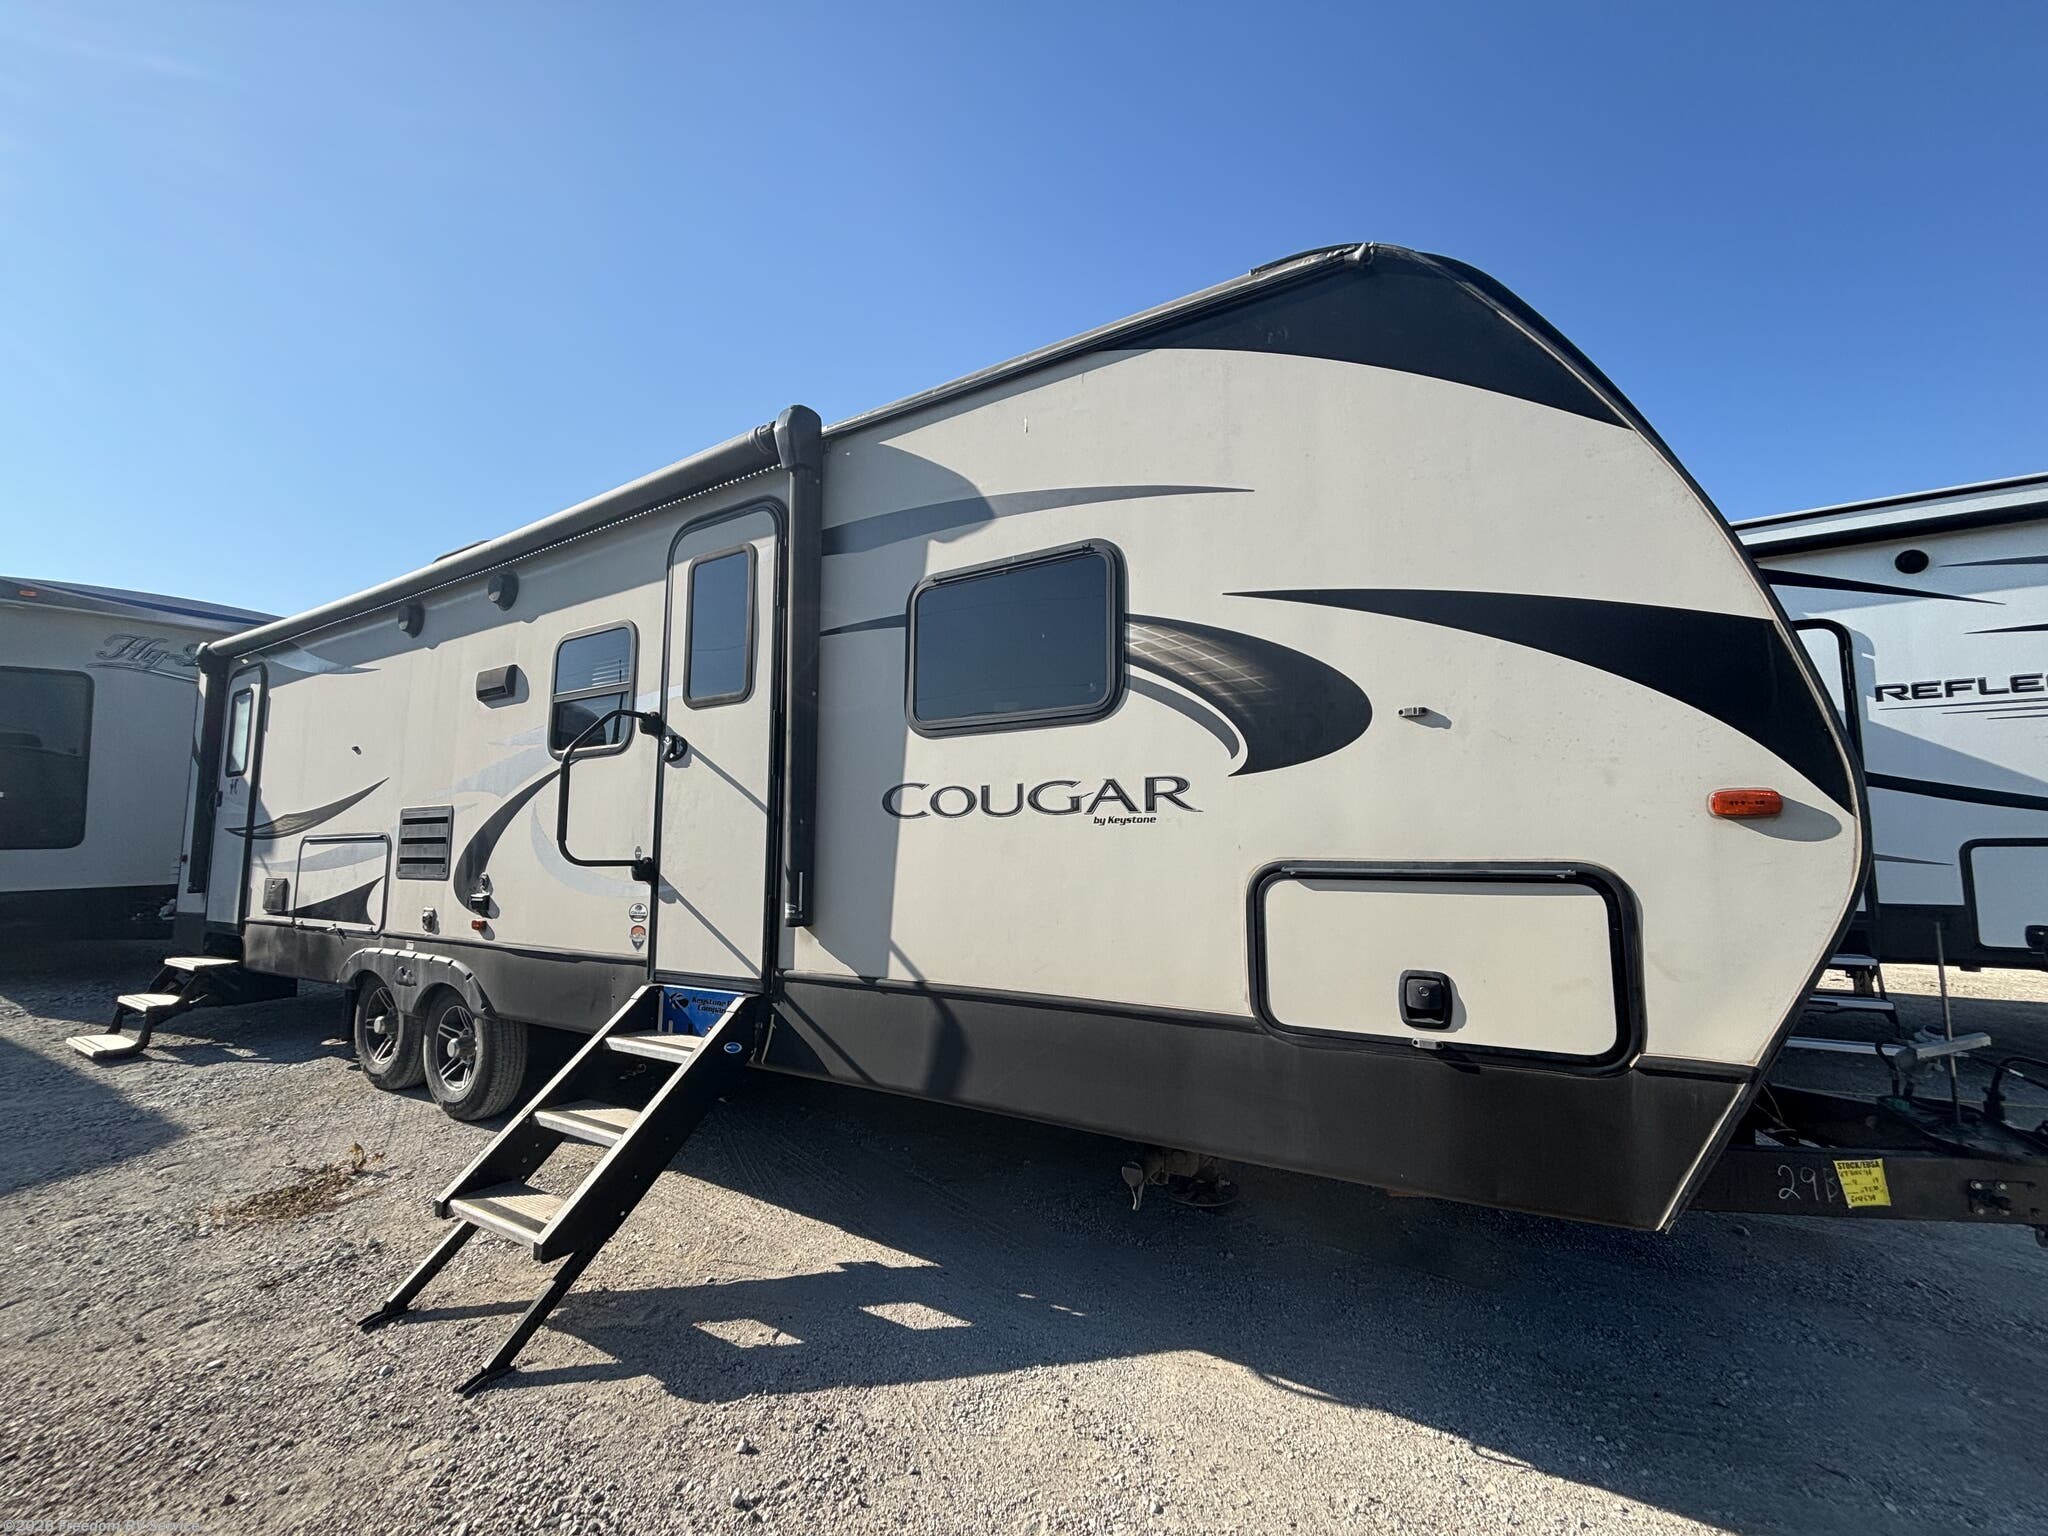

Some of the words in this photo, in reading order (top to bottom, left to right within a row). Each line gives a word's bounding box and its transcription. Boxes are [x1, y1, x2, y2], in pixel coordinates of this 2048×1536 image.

[1875, 672, 2048, 702] REFLE
[881, 775, 1203, 819] COUGAR
[1093, 816, 1107, 826] by
[1107, 815, 1157, 826] Keystone
